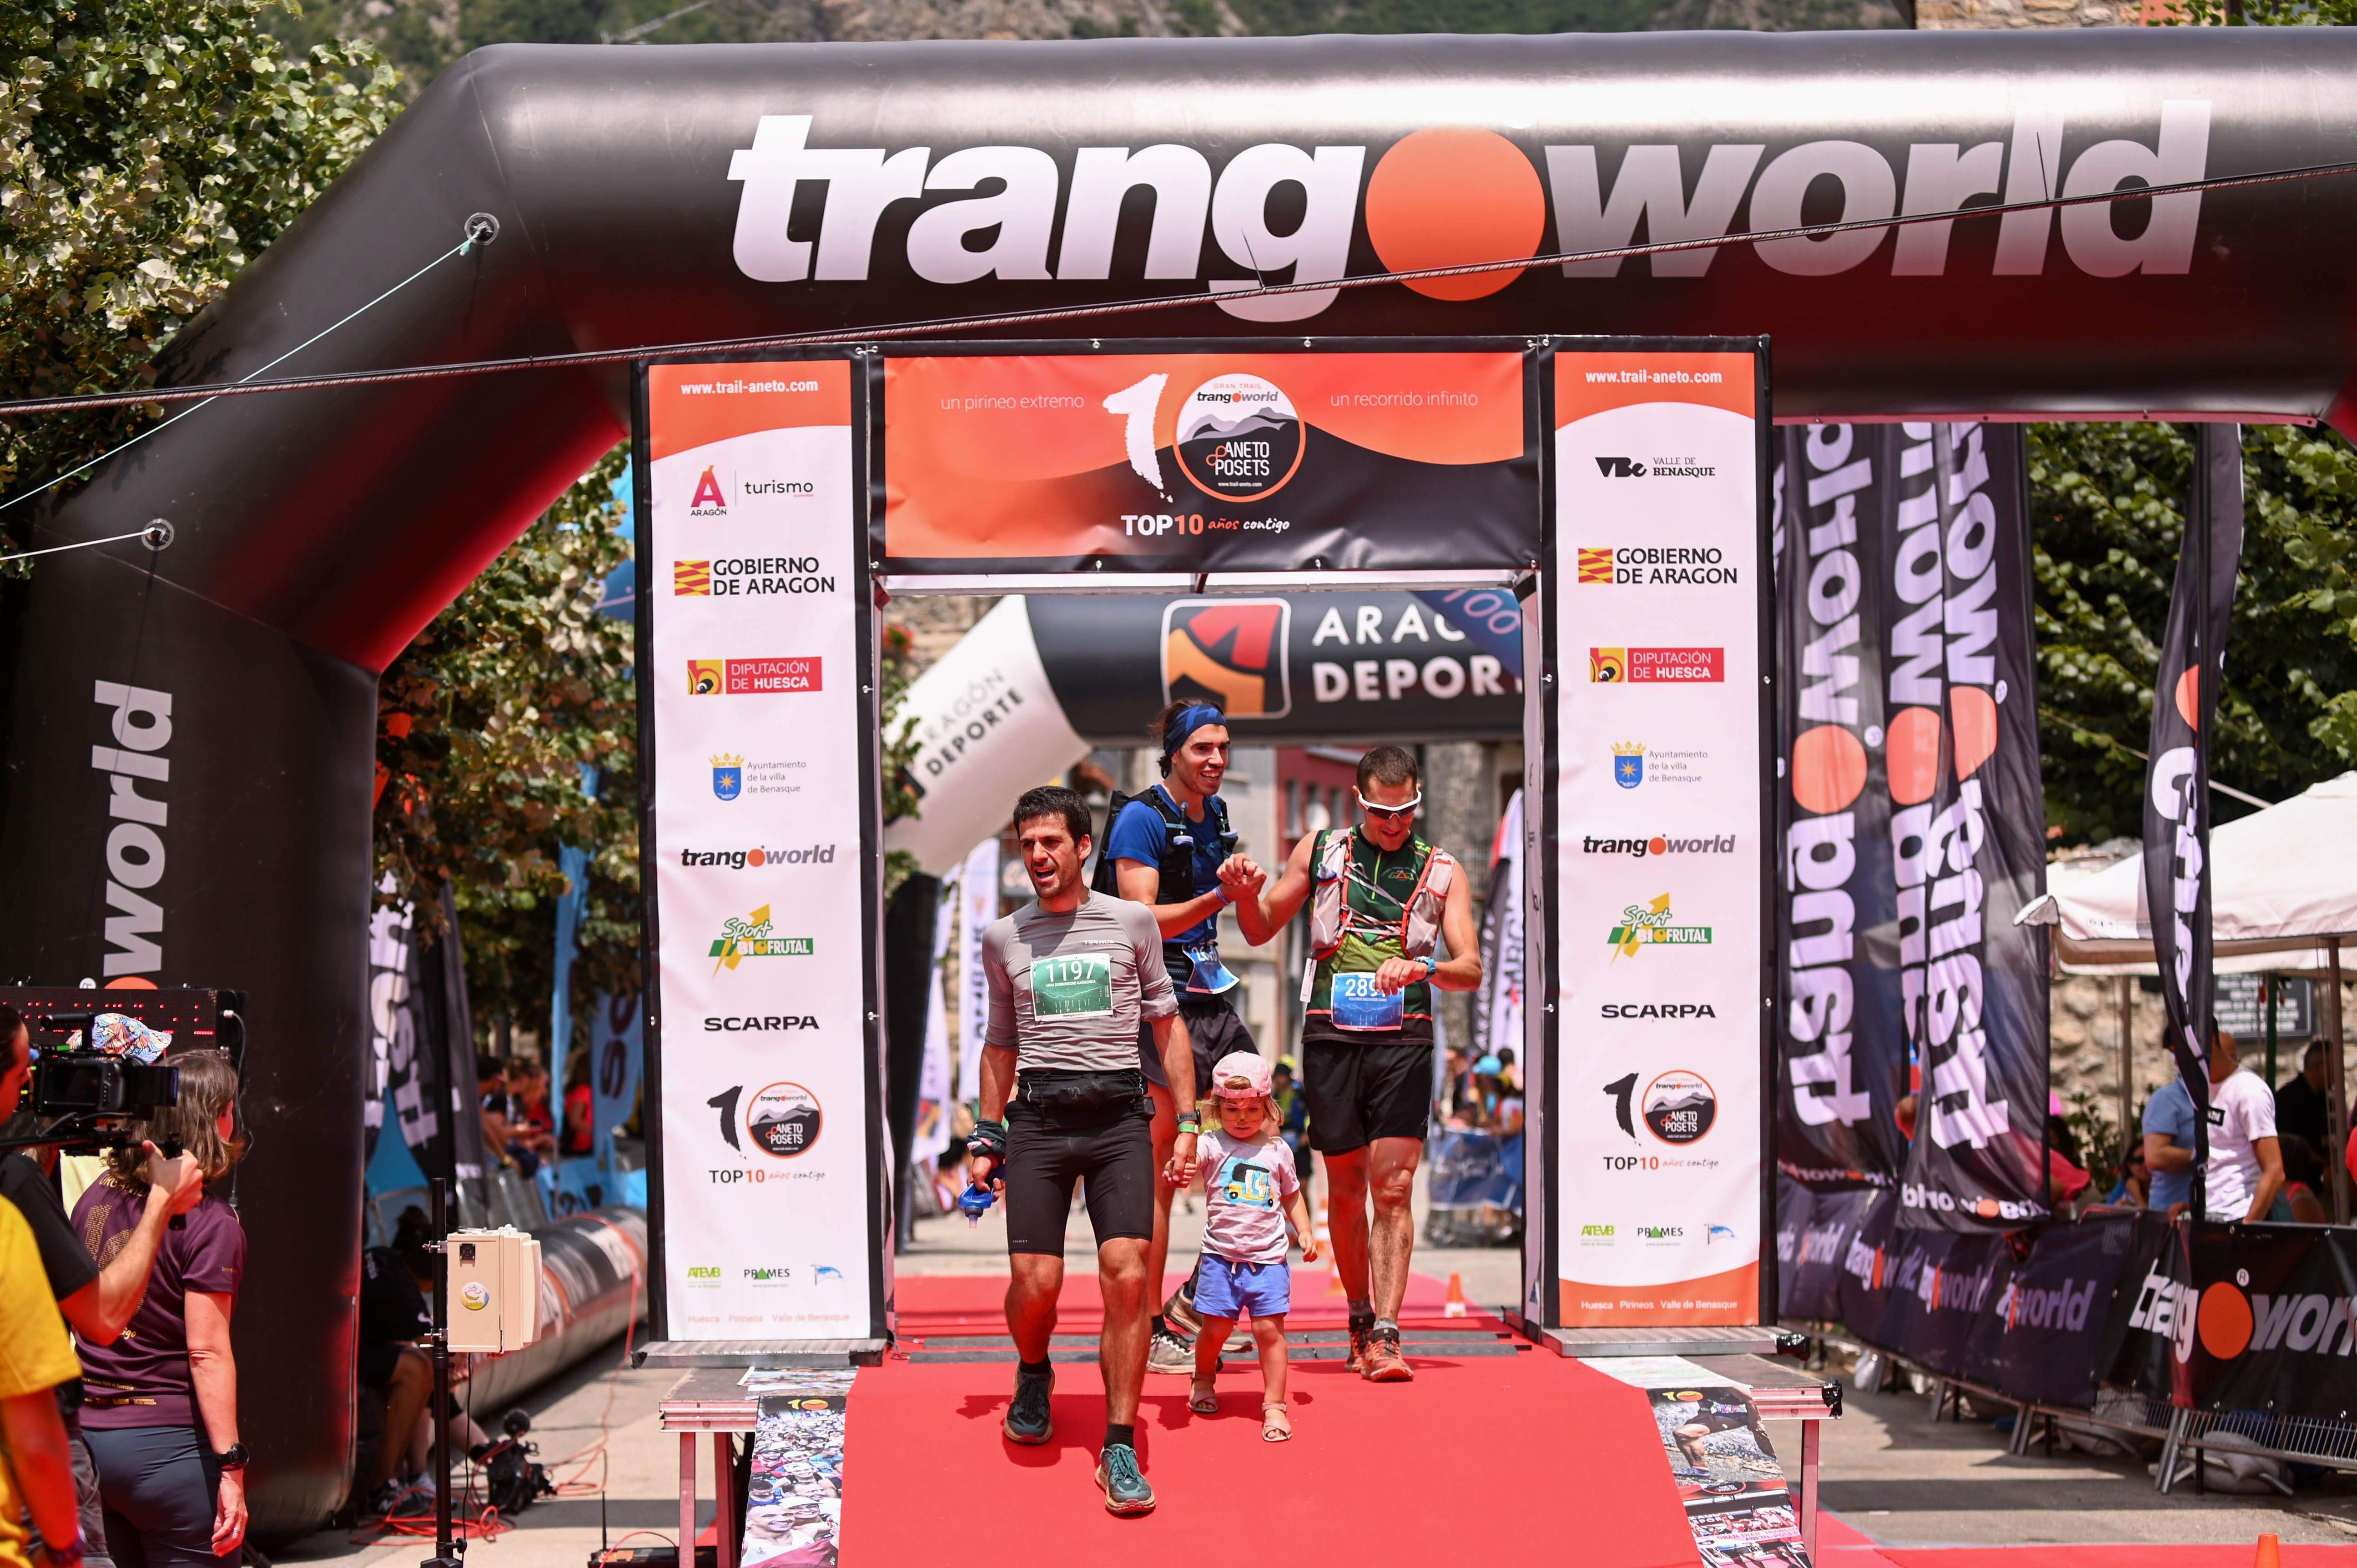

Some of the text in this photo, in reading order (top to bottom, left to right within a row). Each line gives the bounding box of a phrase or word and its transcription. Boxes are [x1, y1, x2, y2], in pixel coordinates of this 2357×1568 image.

[1586, 369, 1722, 383] www.trail-aneto.com
[681, 379, 819, 395] www.trail-aneto.com
[941, 395, 1084, 412] un pirineo extremo
[1331, 391, 1478, 406] un recorrido infinito
[1226, 441, 1269, 458] ANETO
[1215, 459, 1269, 476] POSETS
[1653, 467, 1716, 478] BENASQUE
[745, 480, 813, 494] turismo
[690, 507, 727, 516] ARAGÓN
[1209, 518, 1239, 530] años
[1243, 518, 1290, 533] contigo
[1617, 548, 1722, 564] GOBIERNO
[713, 557, 819, 576] GOBIERNO
[1617, 568, 1738, 584] DE ARAGON
[714, 576, 835, 595] DE ARAGON
[1634, 649, 1711, 665] DIPUTACIÓN
[731, 661, 810, 675] DIPUTACIÓN
[1634, 667, 1711, 679] DE HUESCA
[731, 677, 809, 690] DE HUESCA
[1312, 655, 1522, 701] DEPOR
[926, 688, 1023, 777] DEPORTE
[1649, 750, 1708, 760] Ayuntamiento
[747, 760, 806, 771] Ayuntamiento
[1649, 762, 1687, 770] de la villa
[747, 772, 786, 781] de la villa
[1649, 774, 1702, 784] de Benasque
[747, 784, 801, 794] de Benasque
[1622, 905, 1672, 930] Sport
[721, 917, 773, 944] Sport
[1637, 927, 1709, 943] BIOFRUTAL
[737, 939, 810, 955] BIOFRUTAL
[1046, 959, 1095, 982] 1197
[1345, 978, 1386, 997] 289
[1601, 1004, 1716, 1018] SCARPA
[704, 1015, 819, 1031] SCARPA
[1672, 1111, 1697, 1122] ANETO
[776, 1123, 803, 1134] ANETO
[1665, 1122, 1697, 1132] POSETS
[771, 1134, 803, 1145] POSETS
[1687, 1159, 1719, 1169] contigo
[793, 1171, 826, 1181] contigo
[1620, 1301, 1654, 1309] Pirineos
[1661, 1301, 1681, 1309] Valle
[1696, 1301, 1738, 1311] Benasque
[688, 1314, 850, 1323] Huesca Pirineos Valle de Benasque
